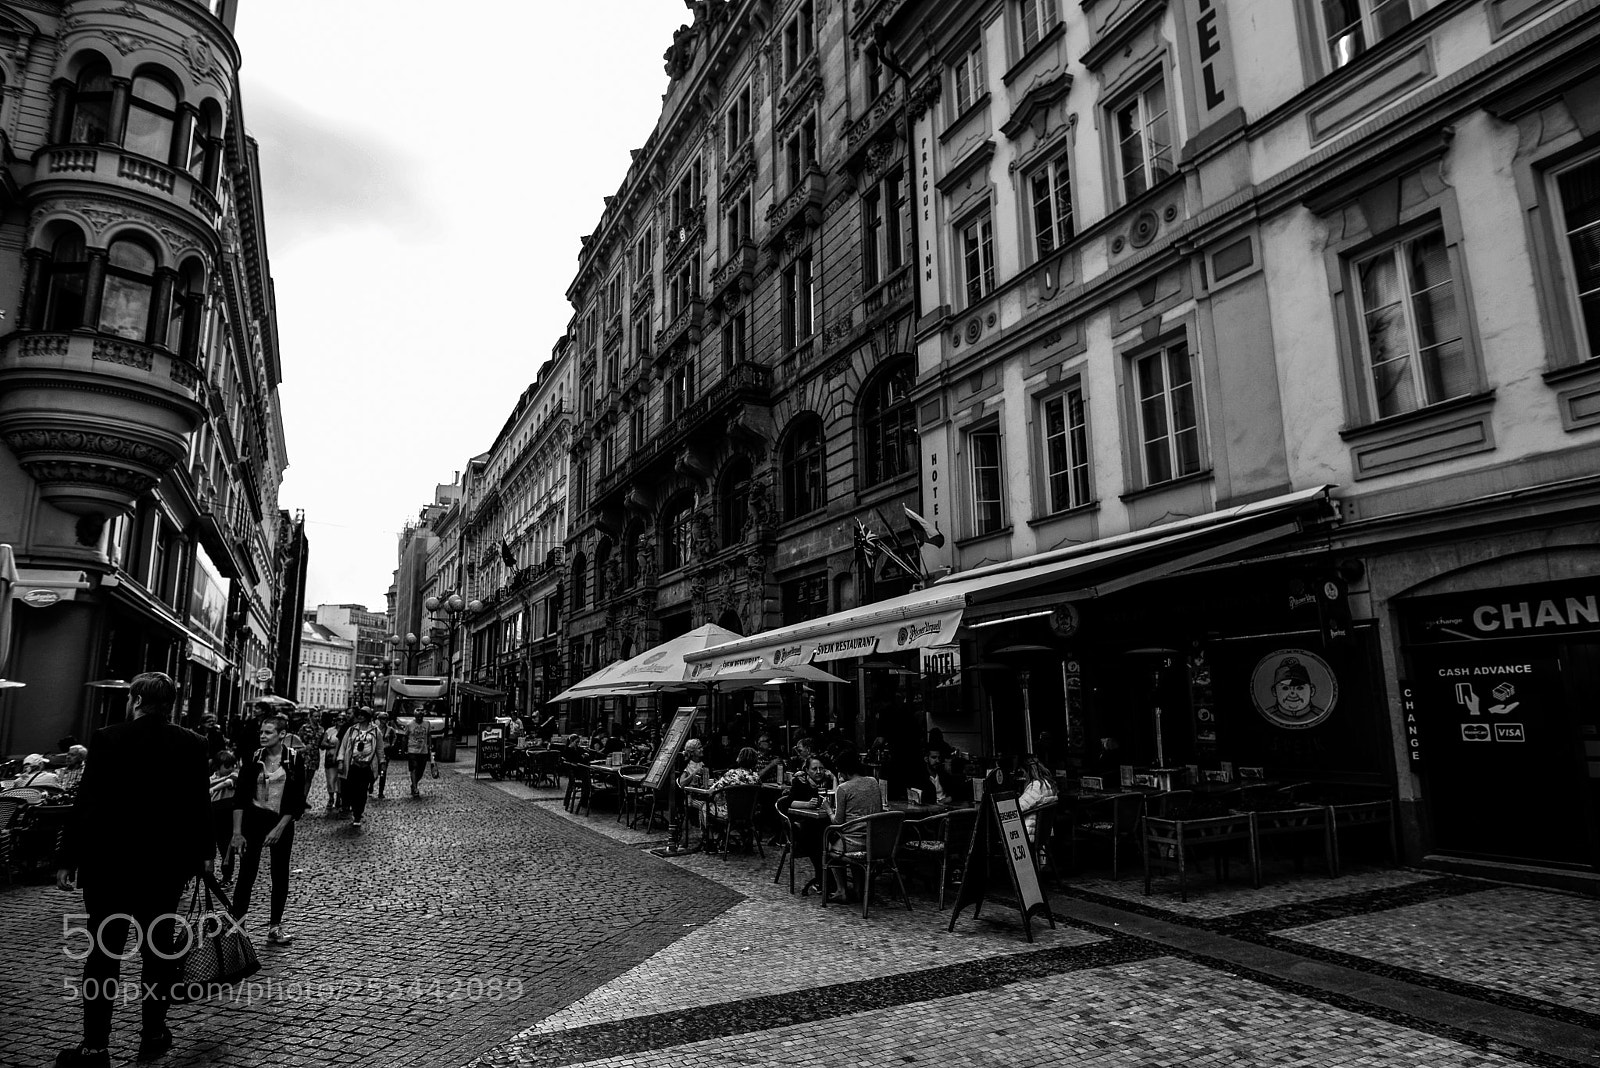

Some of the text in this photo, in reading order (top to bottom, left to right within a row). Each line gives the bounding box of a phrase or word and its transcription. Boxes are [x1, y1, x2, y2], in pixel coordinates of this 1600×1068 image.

[835, 635, 876, 652] RESTAURANT
[923, 652, 957, 675] HOTEL
[1438, 664, 1532, 677] CASH ADVANCE
[1403, 688, 1420, 760] CHANGE
[1498, 729, 1521, 737] VISA
